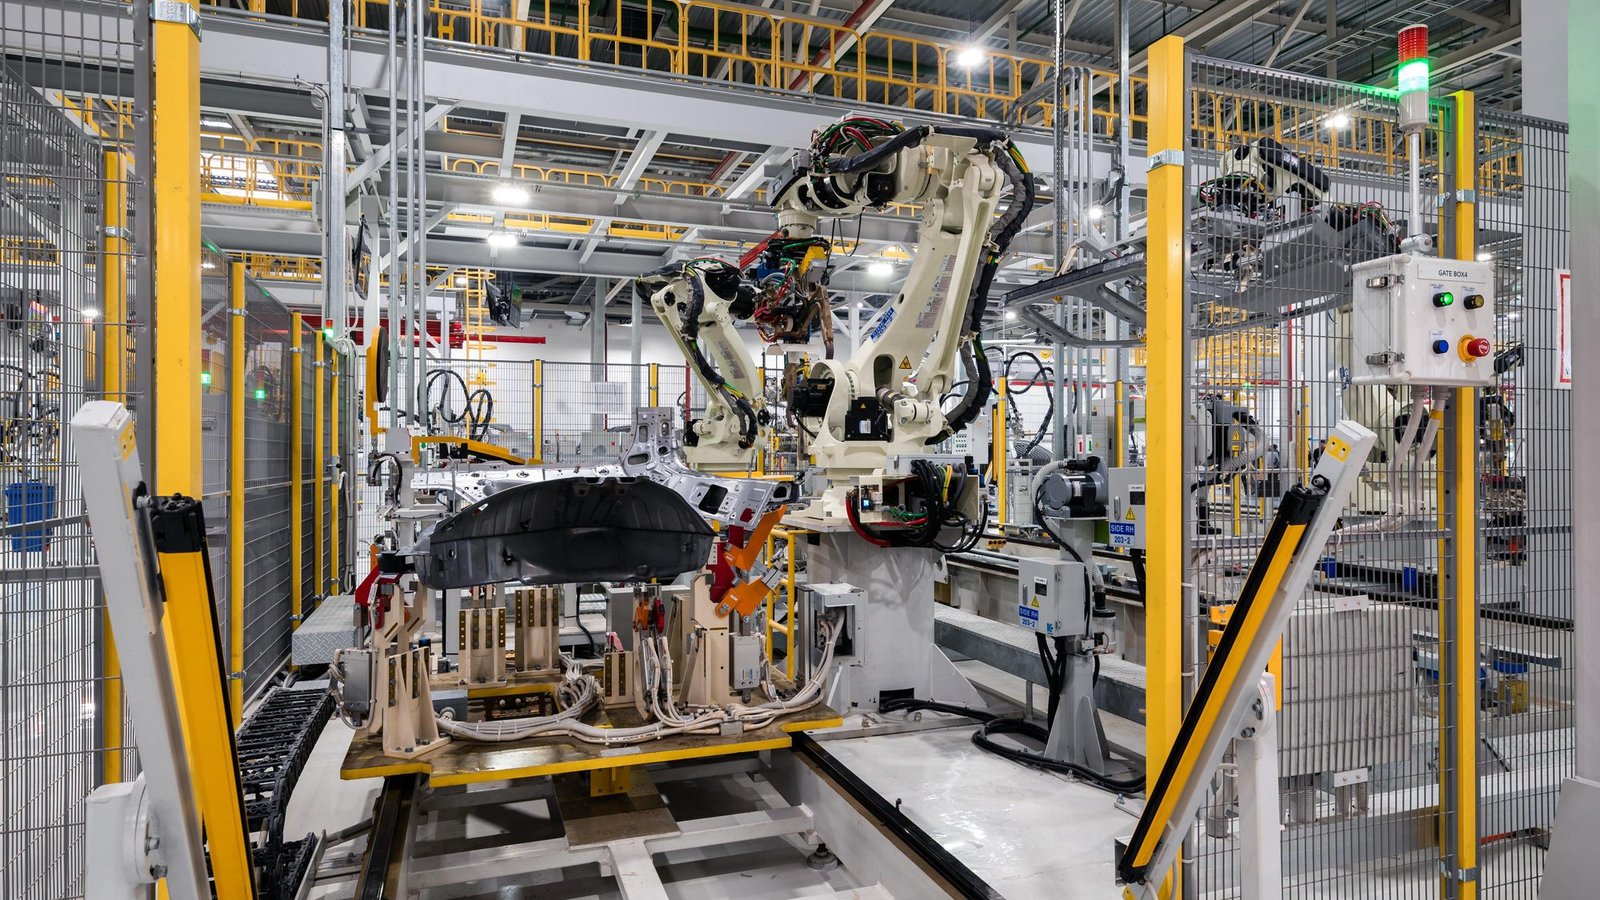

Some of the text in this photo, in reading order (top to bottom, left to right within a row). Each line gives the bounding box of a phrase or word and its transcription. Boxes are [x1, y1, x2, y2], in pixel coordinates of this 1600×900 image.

[1110, 524, 1134, 534] SIDE RH
[1114, 535, 1131, 544] 203-2
